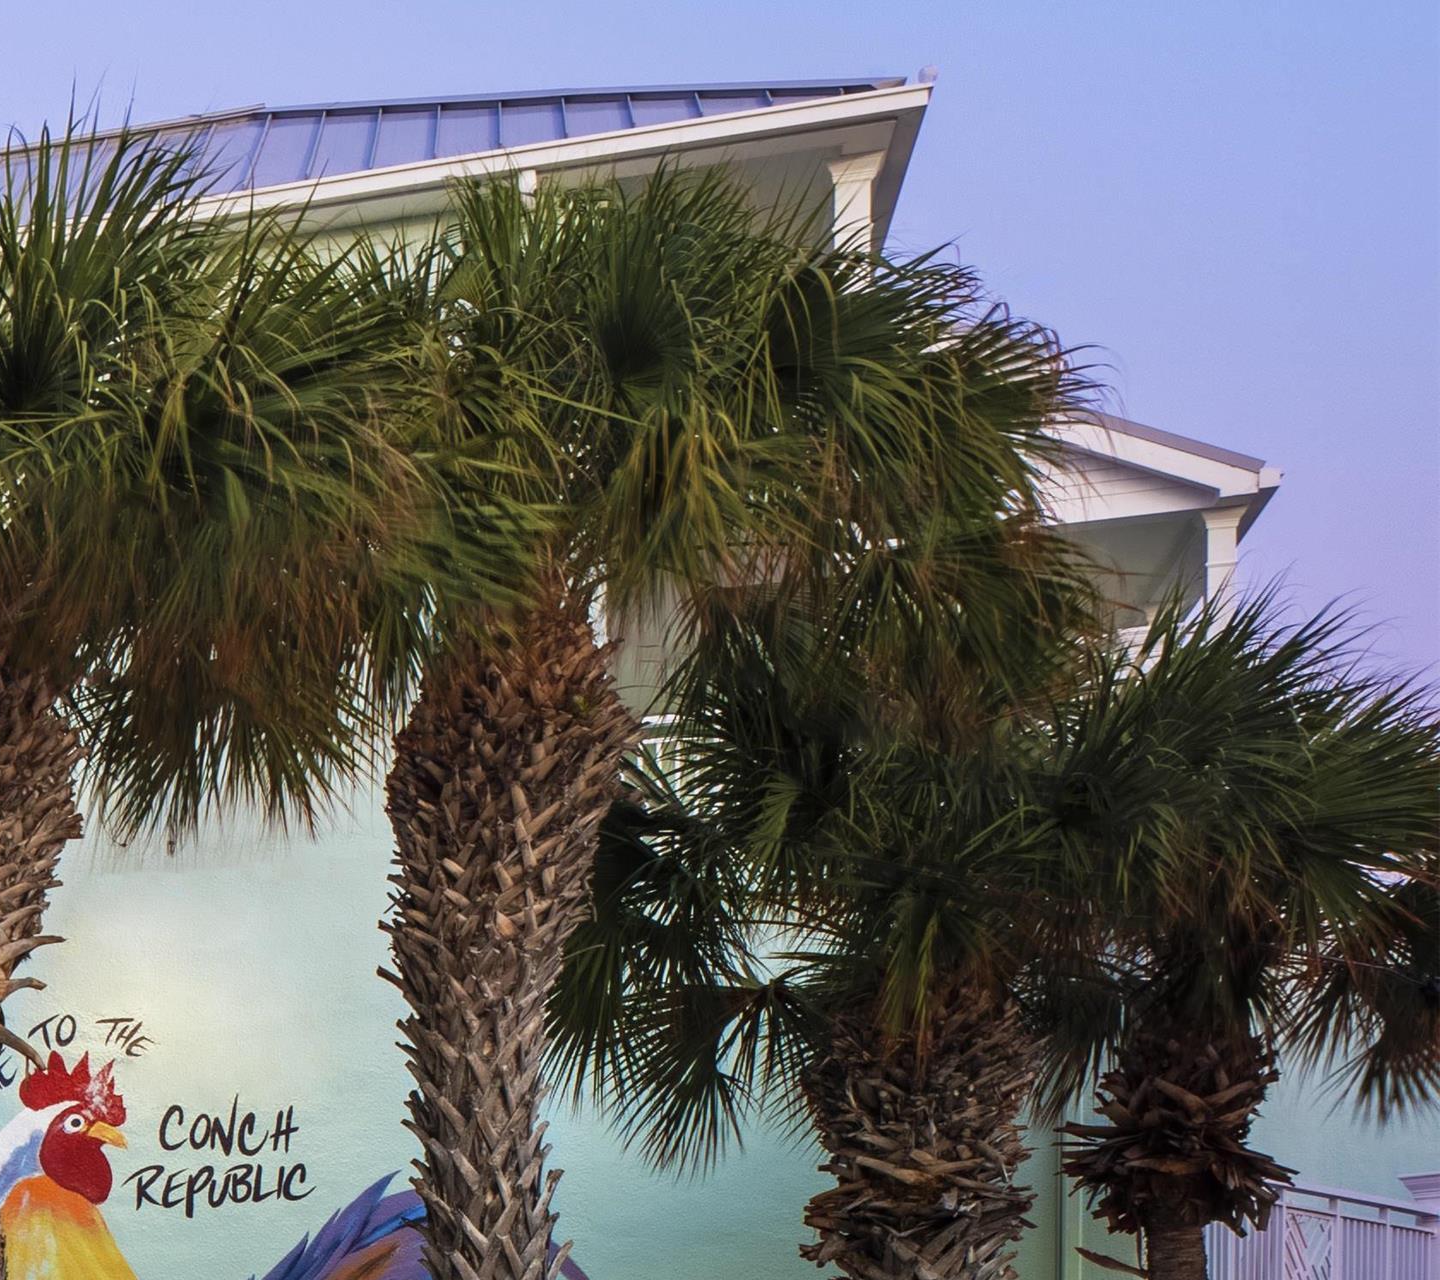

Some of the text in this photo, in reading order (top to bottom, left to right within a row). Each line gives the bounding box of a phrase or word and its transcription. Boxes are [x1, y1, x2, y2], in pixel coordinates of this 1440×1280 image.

[27, 1014, 155, 1057] TO THE
[158, 1093, 300, 1157] CONCH
[121, 1162, 317, 1219] REPUBLIC
